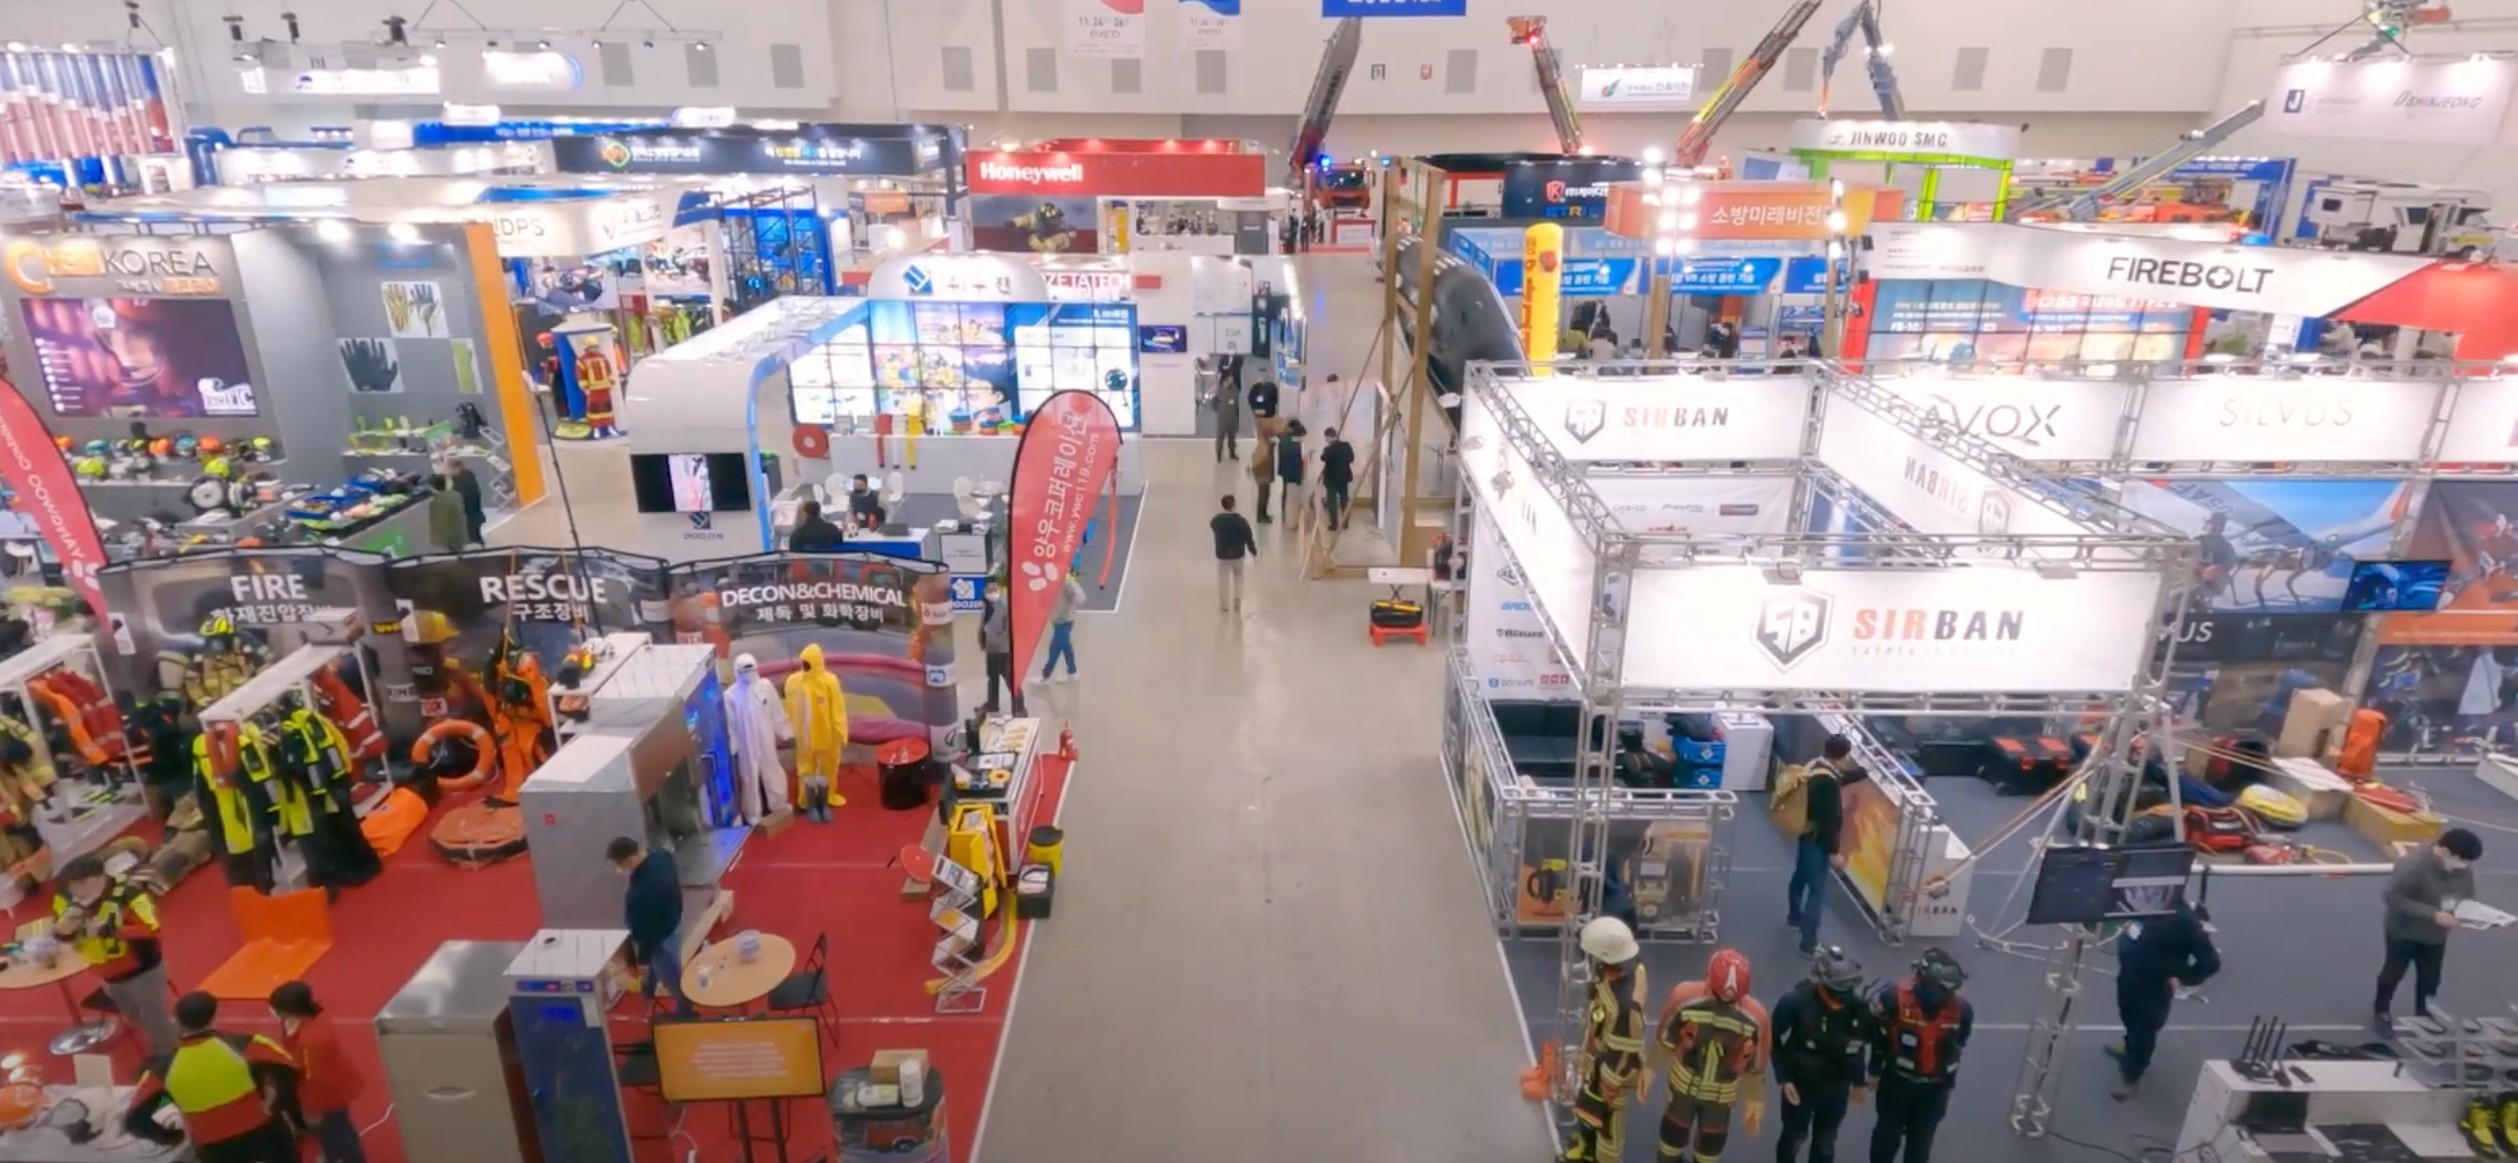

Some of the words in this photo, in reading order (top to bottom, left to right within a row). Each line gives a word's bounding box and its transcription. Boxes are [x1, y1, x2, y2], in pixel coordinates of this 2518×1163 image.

[1850, 131, 1908, 146] JINWOO
[1914, 132, 1948, 147] SMC
[980, 161, 1082, 184] Honeywell
[2107, 256, 2275, 294] FIREBOLT
[1624, 407, 1728, 427] SIRBAN
[2220, 399, 2354, 426] SILVUS
[1033, 412, 1089, 558] 양우코퍼레이션
[1062, 433, 1100, 552] www.ywc119.com
[230, 574, 308, 601] FIRE
[479, 574, 608, 603] RESCUE
[721, 581, 907, 608] DECON&CHEMICAL
[513, 602, 589, 622] 구조장비
[799, 603, 816, 620] 및
[1853, 608, 2024, 641] SIRBAN
